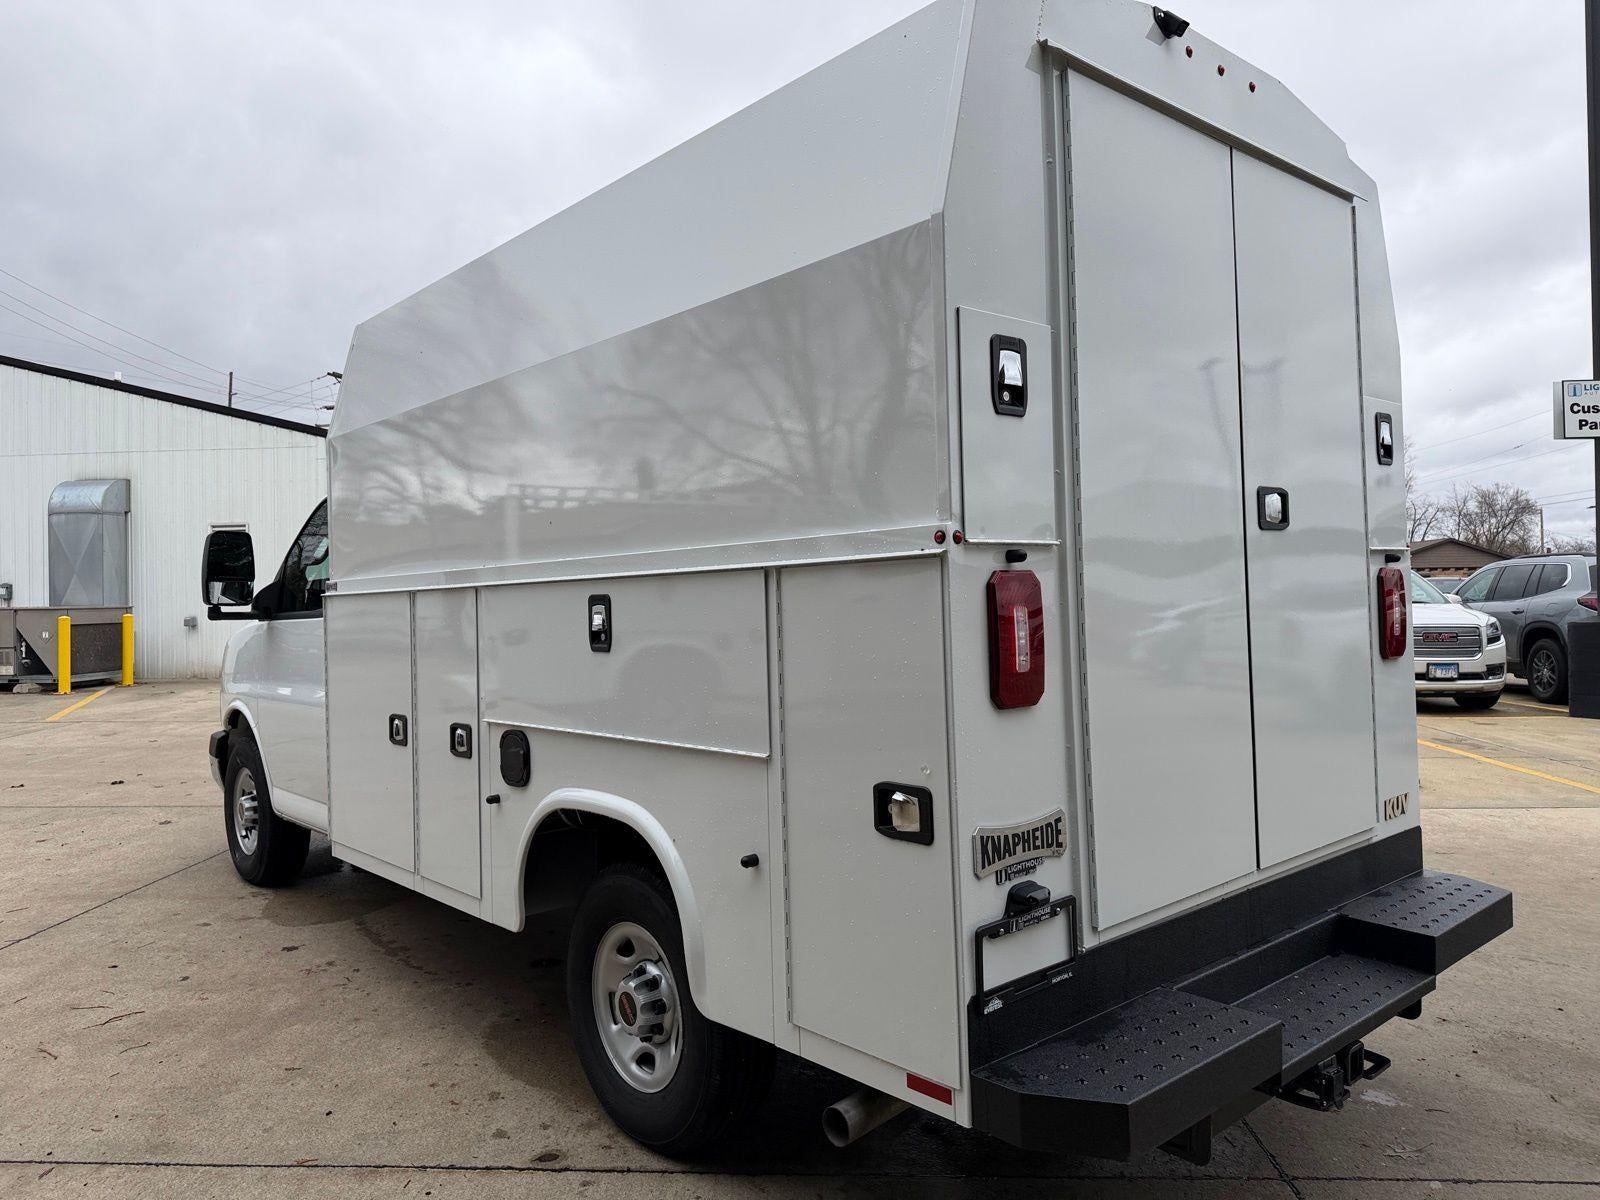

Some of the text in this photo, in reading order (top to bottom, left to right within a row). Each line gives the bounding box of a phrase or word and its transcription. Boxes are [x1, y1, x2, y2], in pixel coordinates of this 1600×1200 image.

[1570, 402, 1600, 414] Cus
[1579, 419, 1600, 430] Pa
[1424, 633, 1457, 642] GMC
[1384, 792, 1409, 822] KUV
[979, 816, 1064, 870] KNAPHEIDE
